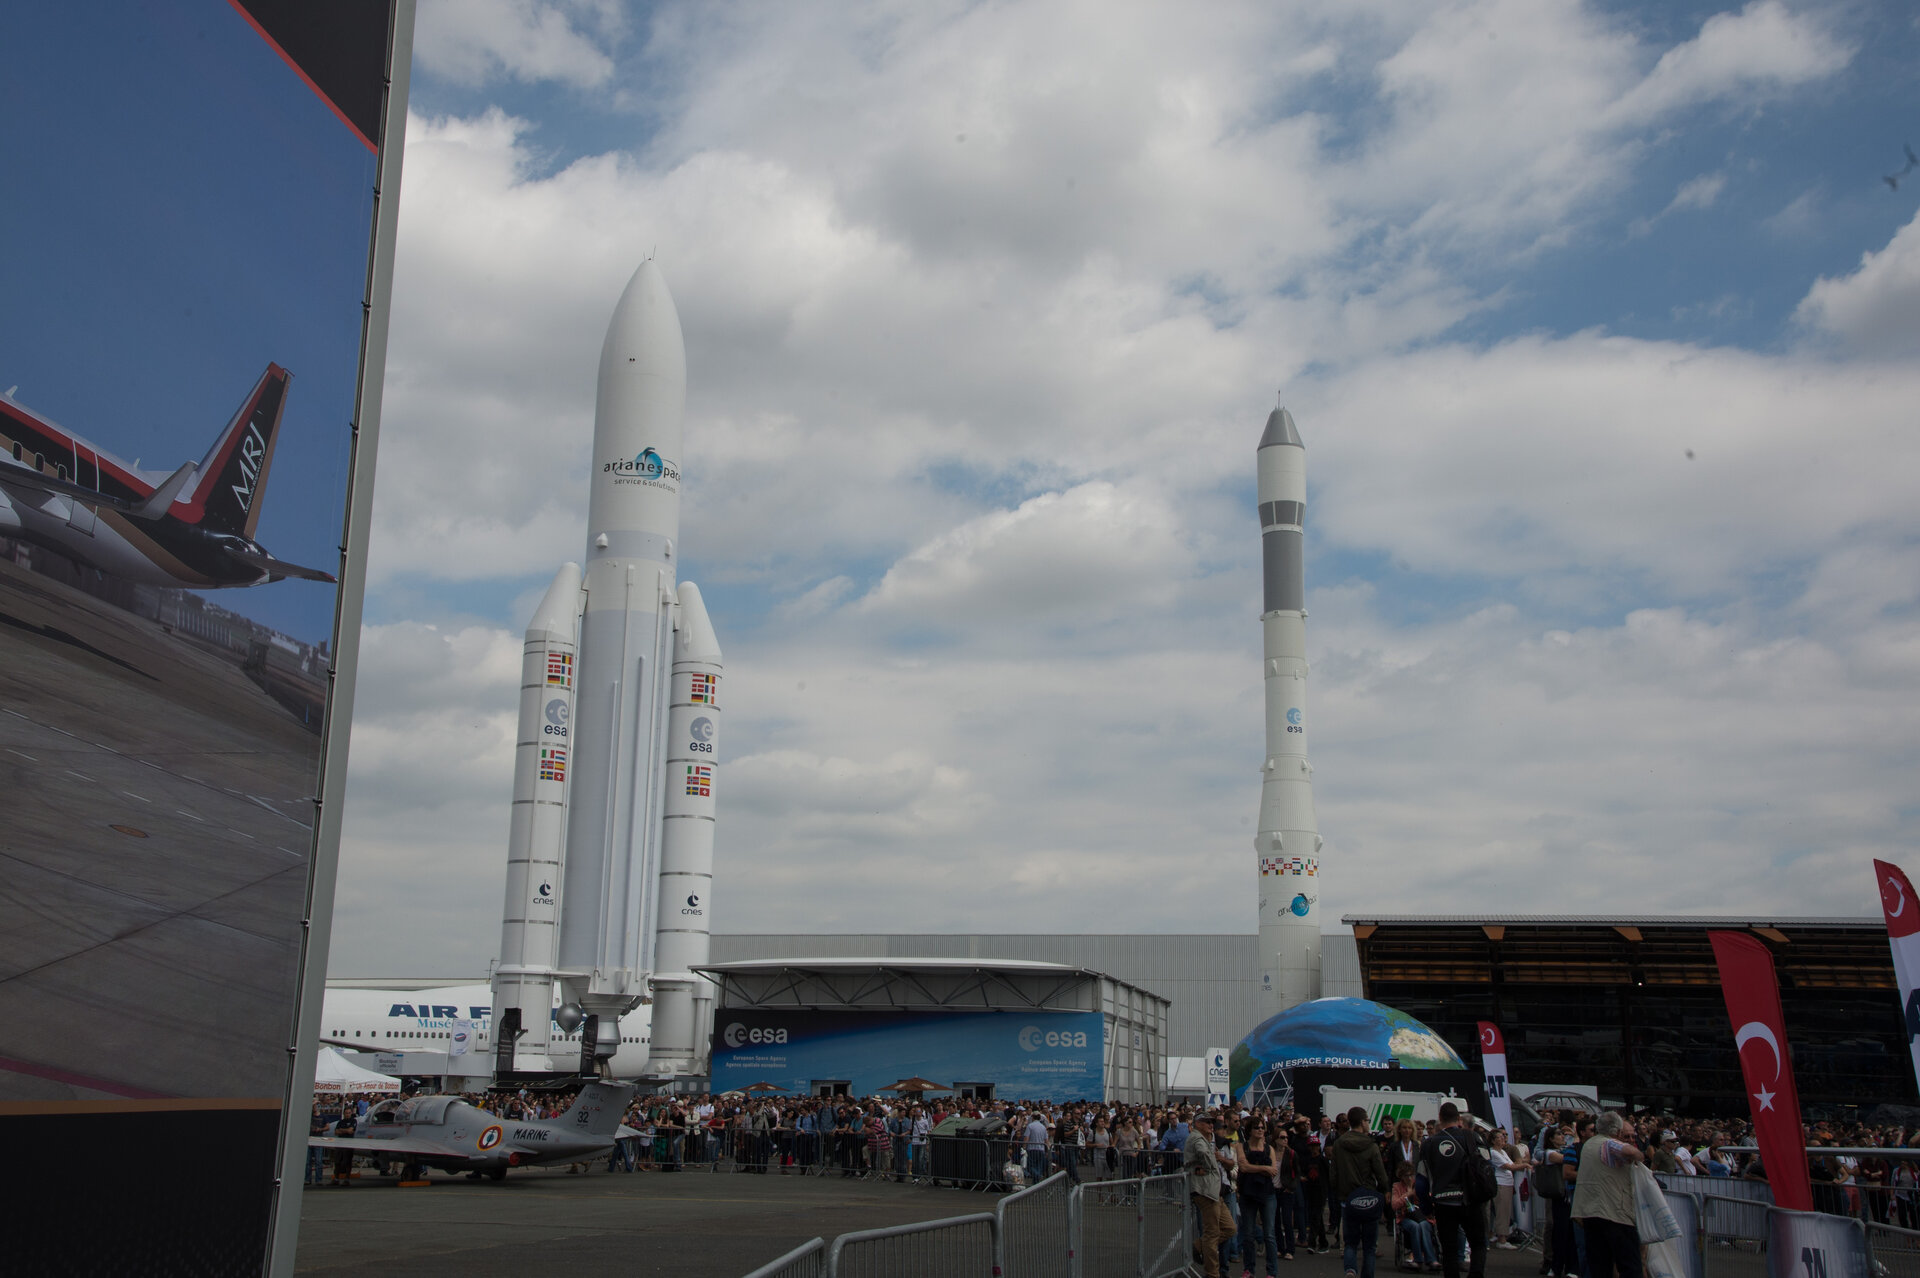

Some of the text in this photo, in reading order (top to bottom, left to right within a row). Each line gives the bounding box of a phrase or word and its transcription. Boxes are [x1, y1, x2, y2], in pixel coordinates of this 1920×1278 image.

[232, 420, 266, 511] MRJ
[648, 479, 676, 494] solutions
[544, 724, 566, 737] esa
[1286, 725, 1302, 734] esa
[690, 742, 712, 753] esa
[532, 897, 554, 906] cnes
[388, 1003, 458, 1019] AIR
[418, 1017, 452, 1029] Musé
[748, 1027, 788, 1044] esa
[1044, 1031, 1086, 1048] esa
[1272, 1061, 1284, 1071] UN
[1286, 1057, 1322, 1068] ESPACE
[1324, 1056, 1352, 1066] POUR
[1354, 1058, 1366, 1067] LE
[1210, 1068, 1228, 1077] cnes
[578, 1111, 588, 1124] 32
[514, 1128, 550, 1141] MARINE
